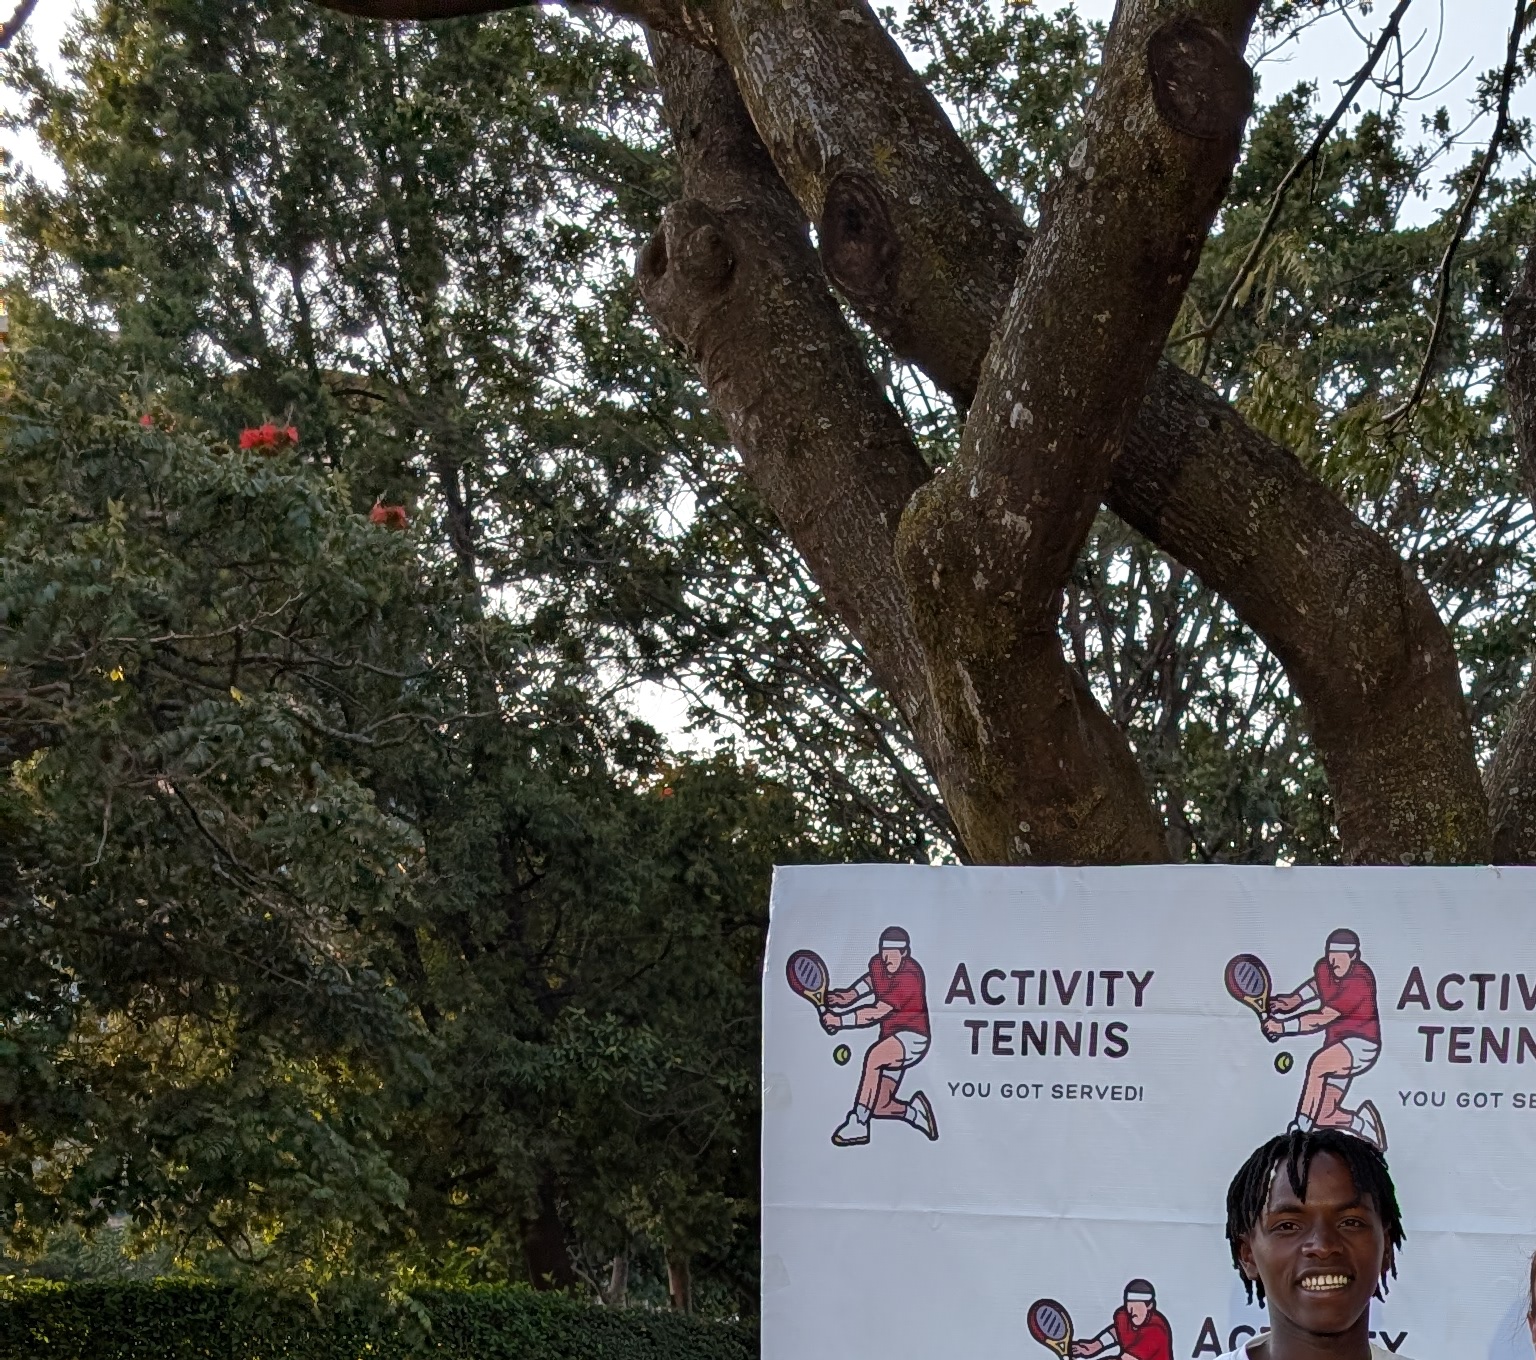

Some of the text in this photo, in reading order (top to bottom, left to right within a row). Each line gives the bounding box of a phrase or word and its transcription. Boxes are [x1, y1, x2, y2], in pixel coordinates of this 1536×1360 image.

[944, 962, 1155, 1008] ACTIVITY
[963, 1019, 1130, 1059] TENNIS
[947, 1081, 1144, 1102] YOU GOT SERVED!
[1398, 1090, 1446, 1107] YOU
[1456, 1092, 1504, 1109] GOT
